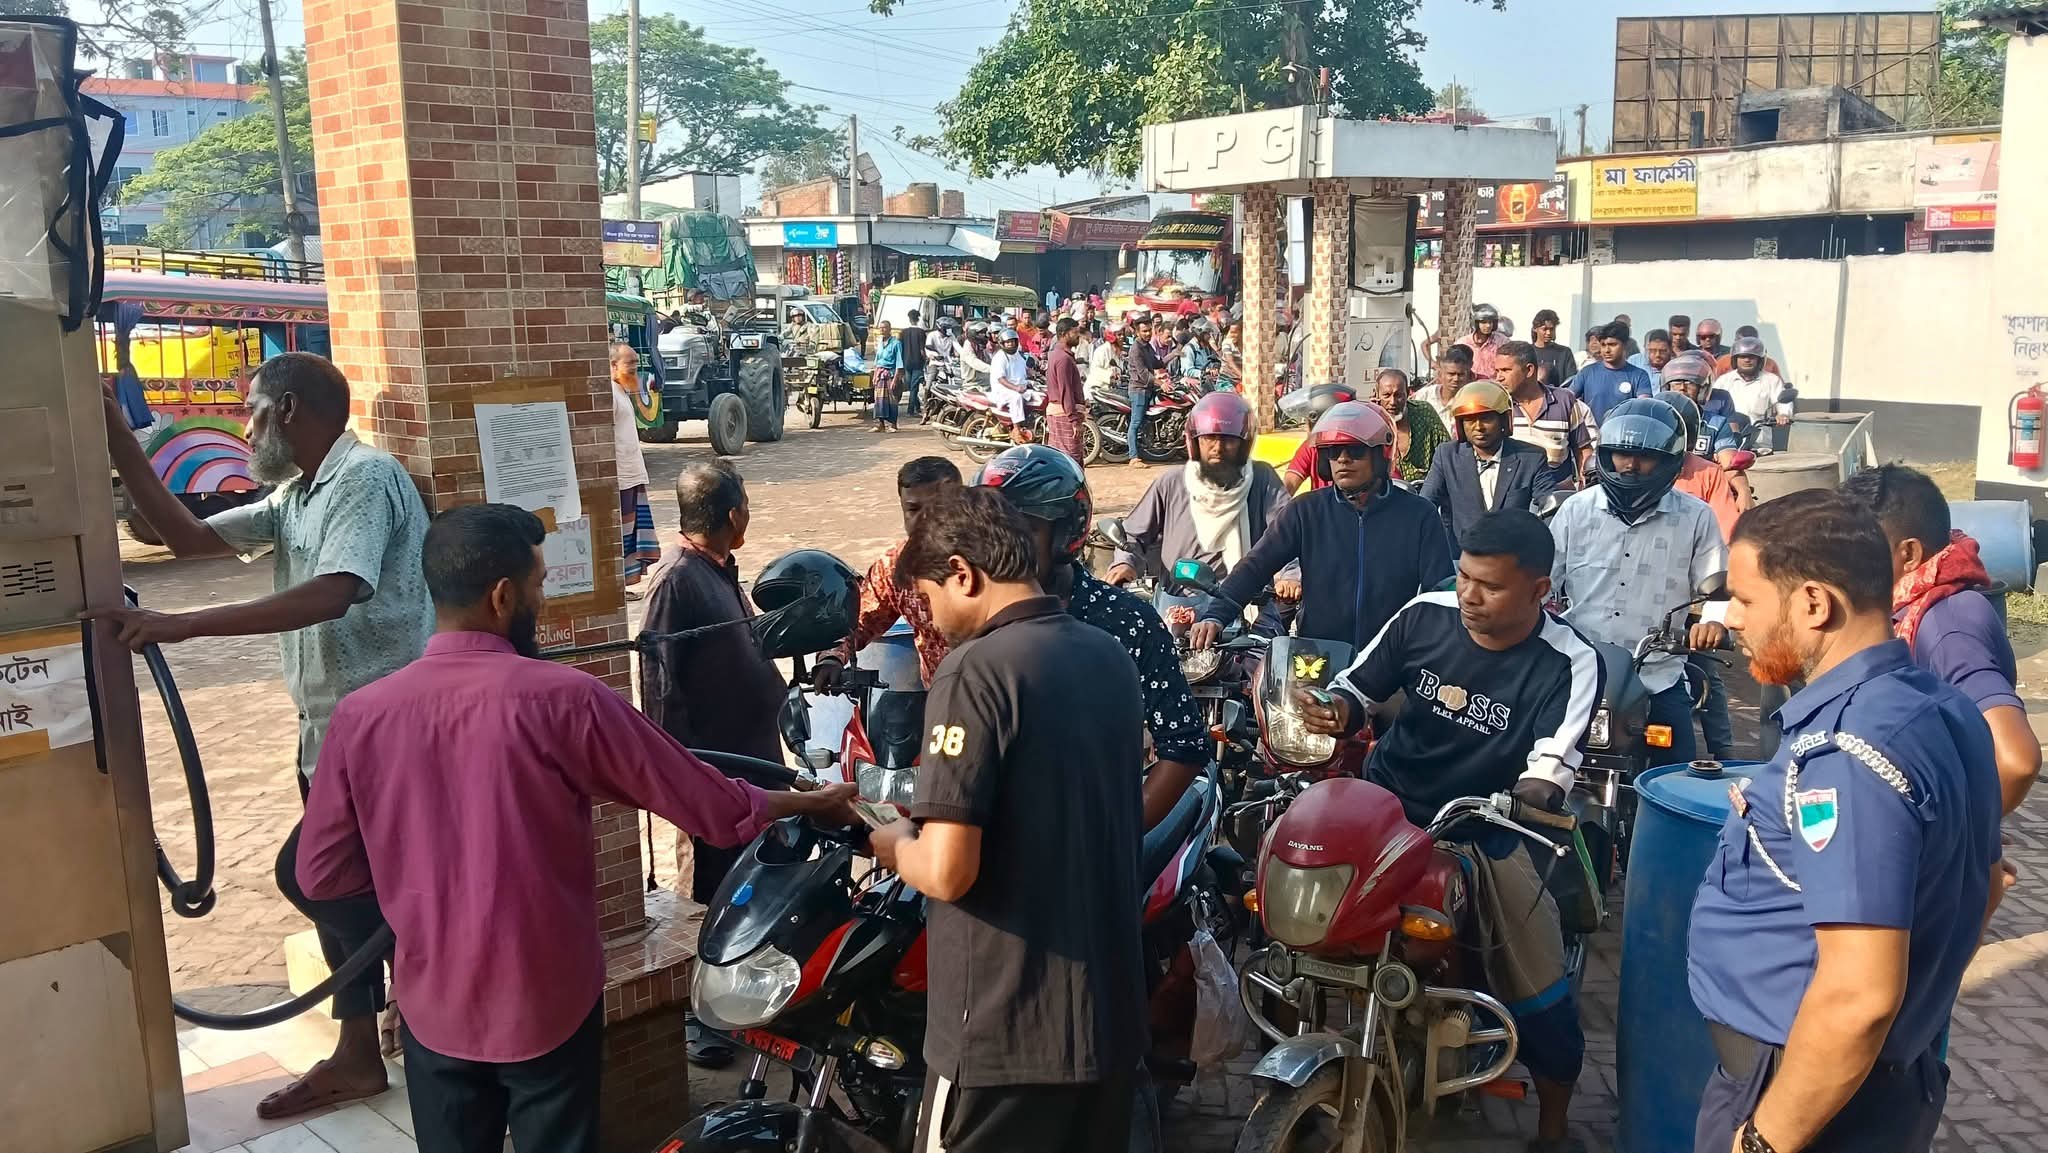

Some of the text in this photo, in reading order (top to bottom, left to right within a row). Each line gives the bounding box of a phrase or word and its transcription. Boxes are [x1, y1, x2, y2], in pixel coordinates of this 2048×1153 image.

[1161, 124, 1295, 174] LPG
[1604, 168, 1626, 184] মা
[535, 627, 571, 645] OKING
[0, 656, 49, 684] টেন
[929, 724, 966, 757] 38
[1287, 840, 1324, 851] DAYANG
